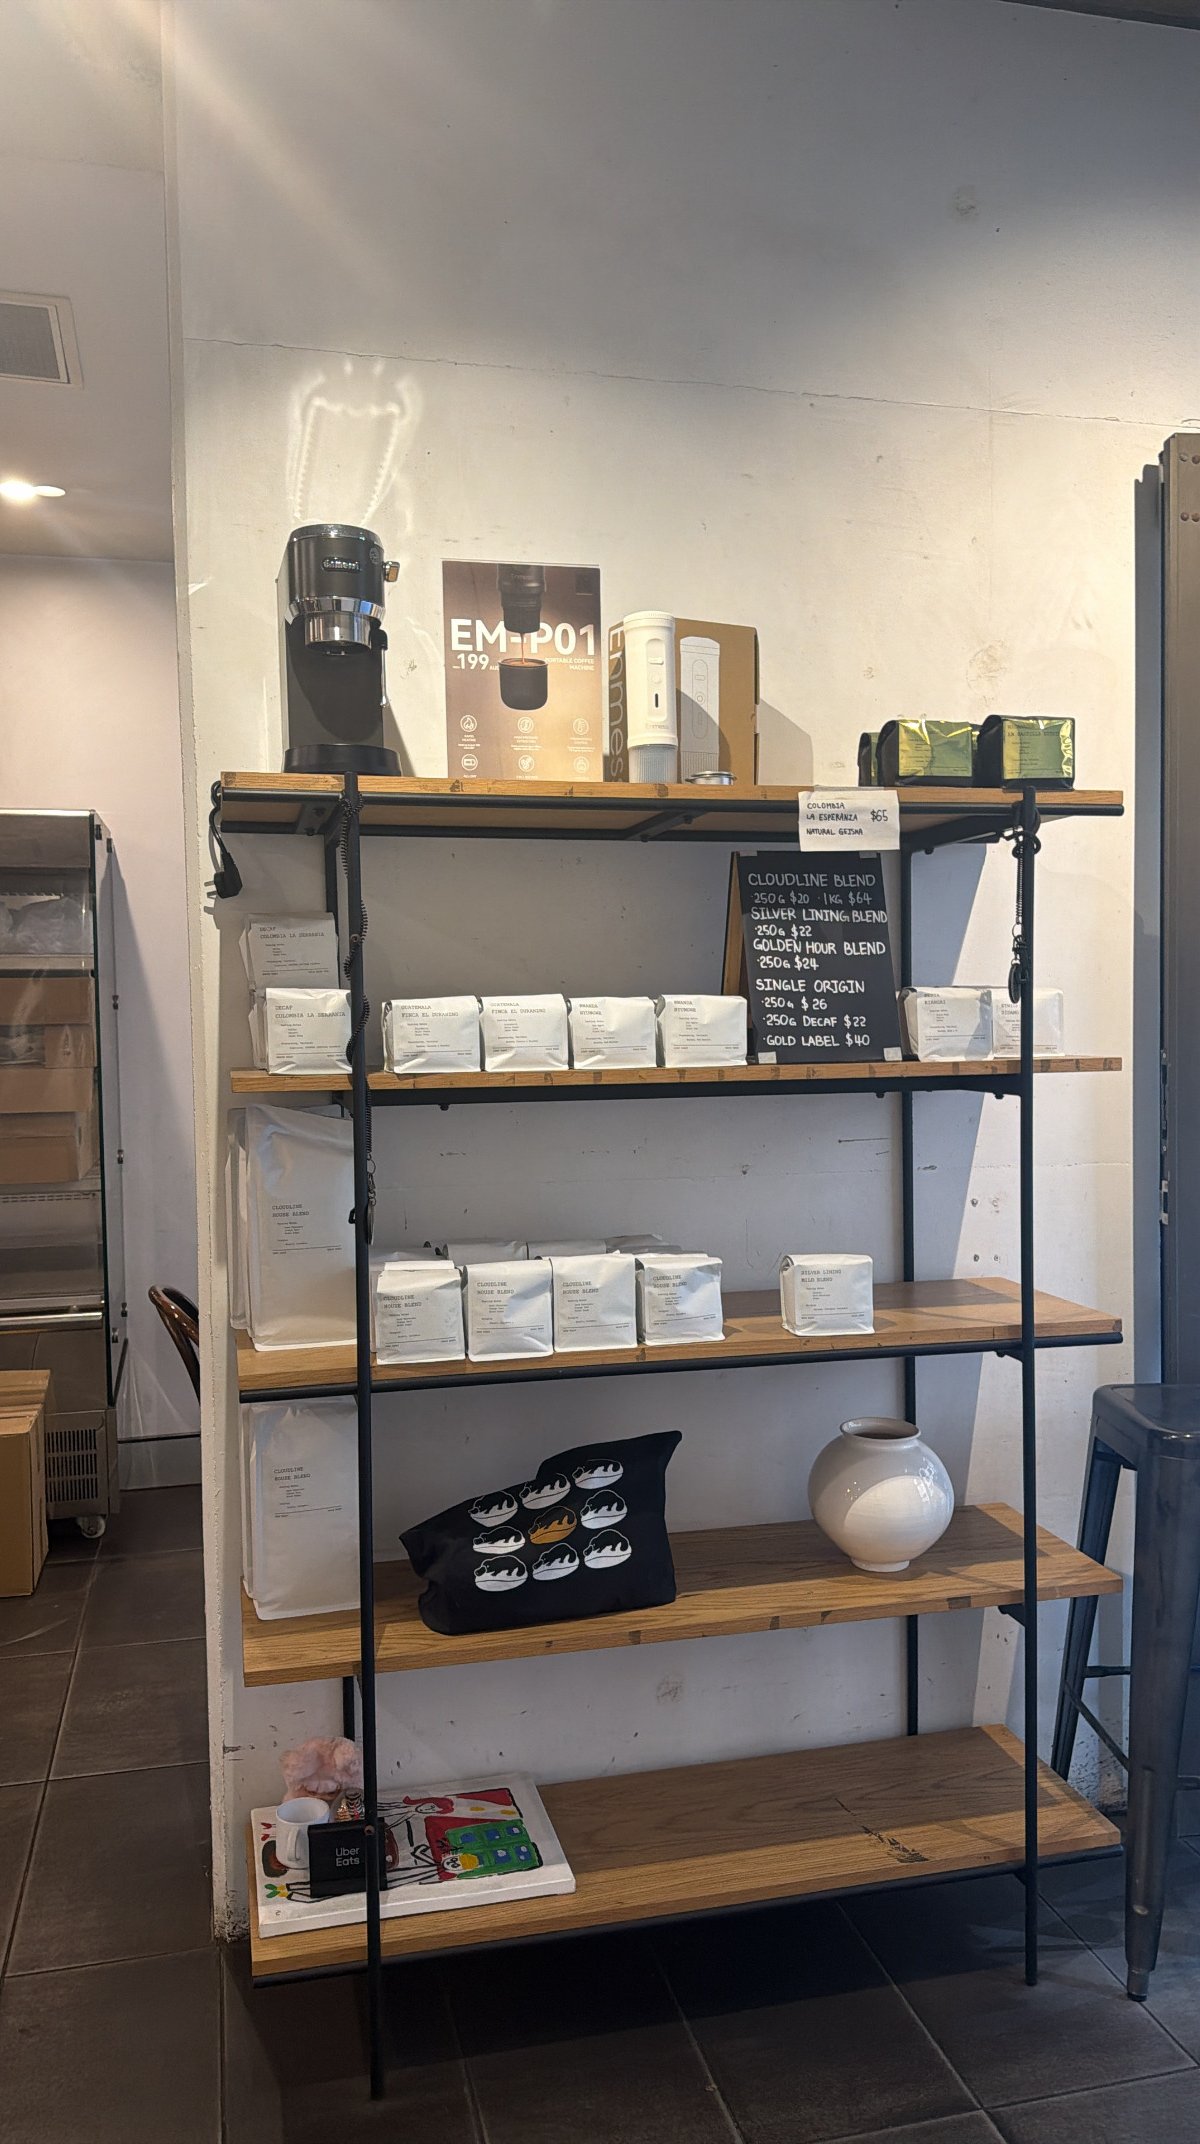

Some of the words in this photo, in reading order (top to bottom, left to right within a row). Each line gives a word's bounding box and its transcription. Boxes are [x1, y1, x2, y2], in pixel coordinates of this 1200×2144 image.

[451, 618, 595, 656] EM-P01
[457, 654, 490, 670] 199
[610, 627, 624, 782] Enmes
[819, 813, 858, 821] ESPERANZA
[870, 809, 888, 822] $65
[748, 873, 828, 887] CLOUDLINE
[834, 874, 875, 887] BLEND
[790, 890, 809, 905] $20
[848, 891, 872, 906] $64
[751, 907, 796, 920] SILVER
[802, 908, 850, 922] LINING
[852, 910, 888, 923] BLEND
[791, 924, 812, 939] $22
[753, 939, 801, 953] GOLDEN
[806, 941, 837, 954] HOUR
[844, 942, 886, 955] BLEND
[794, 954, 819, 971] $24
[756, 979, 806, 991] SINGLE
[814, 980, 865, 993] ORIGIN
[803, 1015, 837, 1027] DECAF
[844, 1014, 866, 1029] $22
[767, 1035, 796, 1046] GOLD
[802, 1036, 840, 1046] LABEL
[845, 1032, 870, 1047] $40
[336, 1848, 360, 1856] Uber
[336, 1857, 360, 1866] Eats
